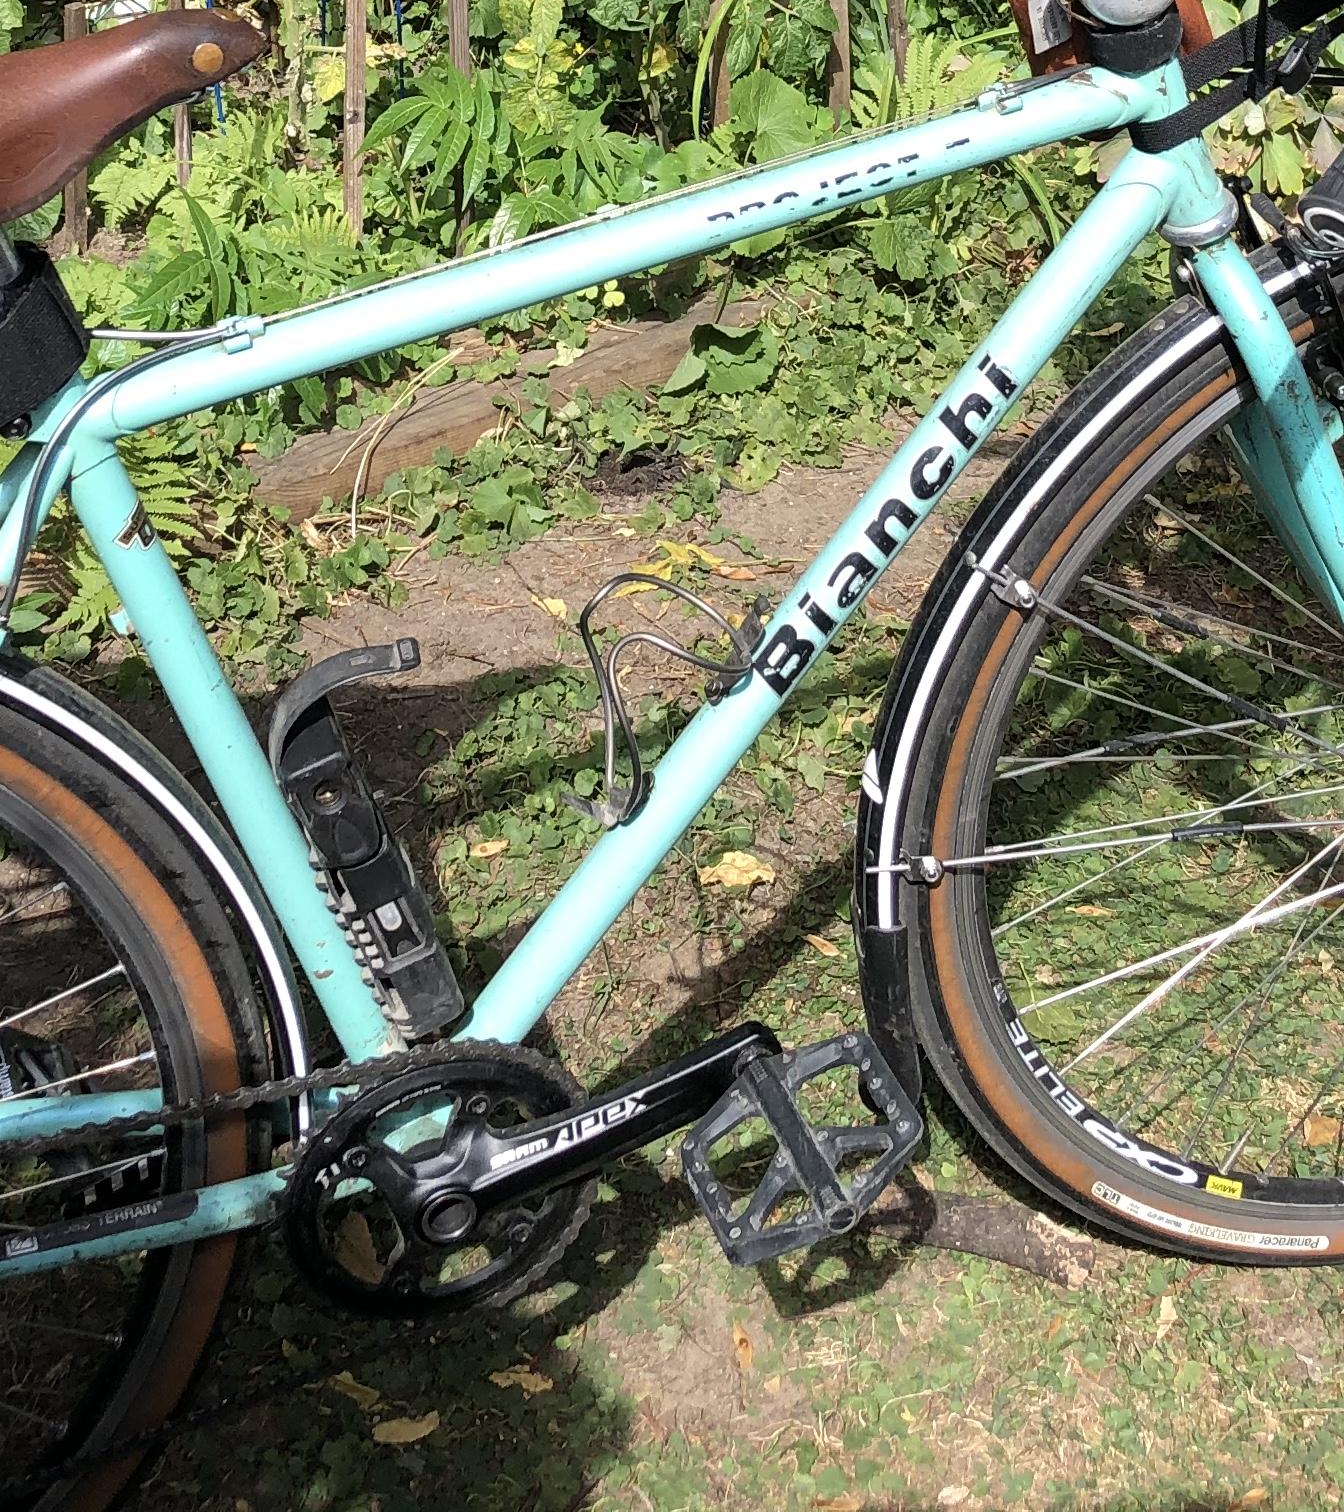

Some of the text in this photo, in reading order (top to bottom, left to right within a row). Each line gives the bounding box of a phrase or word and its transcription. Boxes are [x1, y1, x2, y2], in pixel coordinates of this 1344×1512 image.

[753, 354, 1018, 697] Bianchi
[1008, 1019, 1199, 1186] CXP ELITE
[489, 1135, 549, 1170] SRAM
[1187, 1222, 1256, 1245] GRAVELKING
[1258, 1234, 1321, 1251] Panaracer
